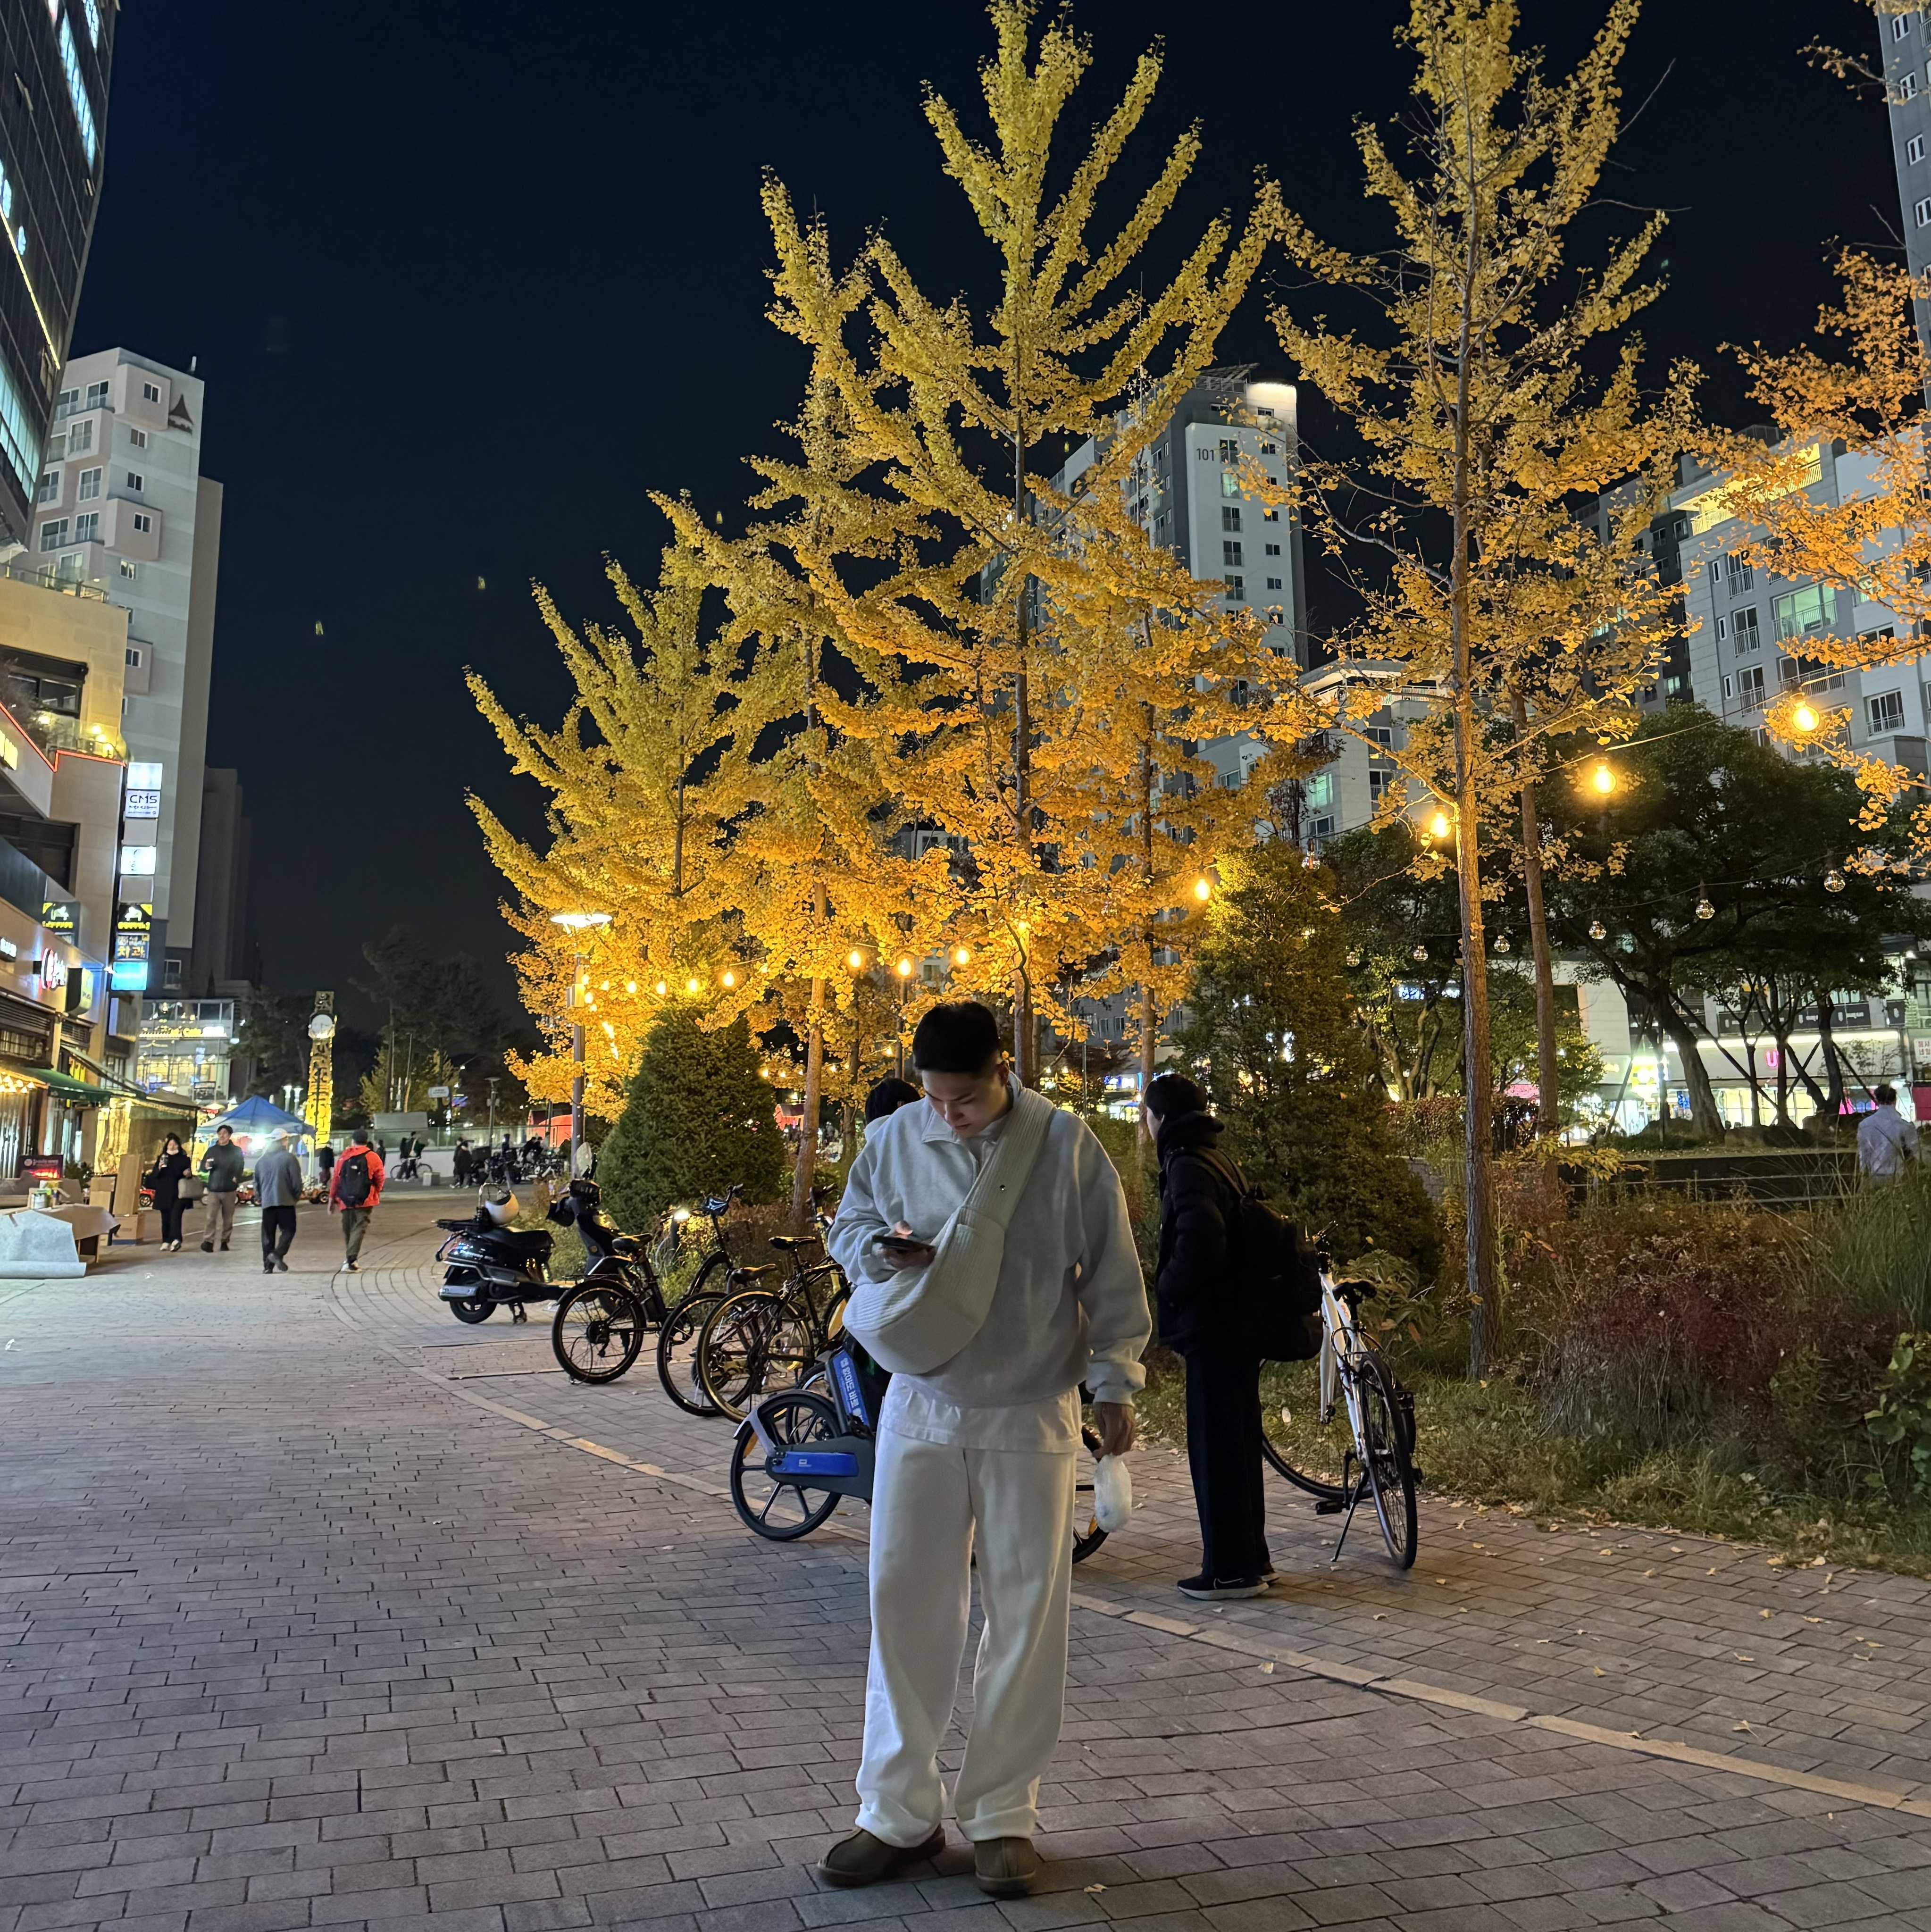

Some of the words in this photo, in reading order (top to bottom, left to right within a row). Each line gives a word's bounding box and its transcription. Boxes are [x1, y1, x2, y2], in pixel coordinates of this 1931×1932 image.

[1196, 448, 1214, 461] 101
[117, 945, 145, 958] 치과
[1766, 1051, 1779, 1067] U
